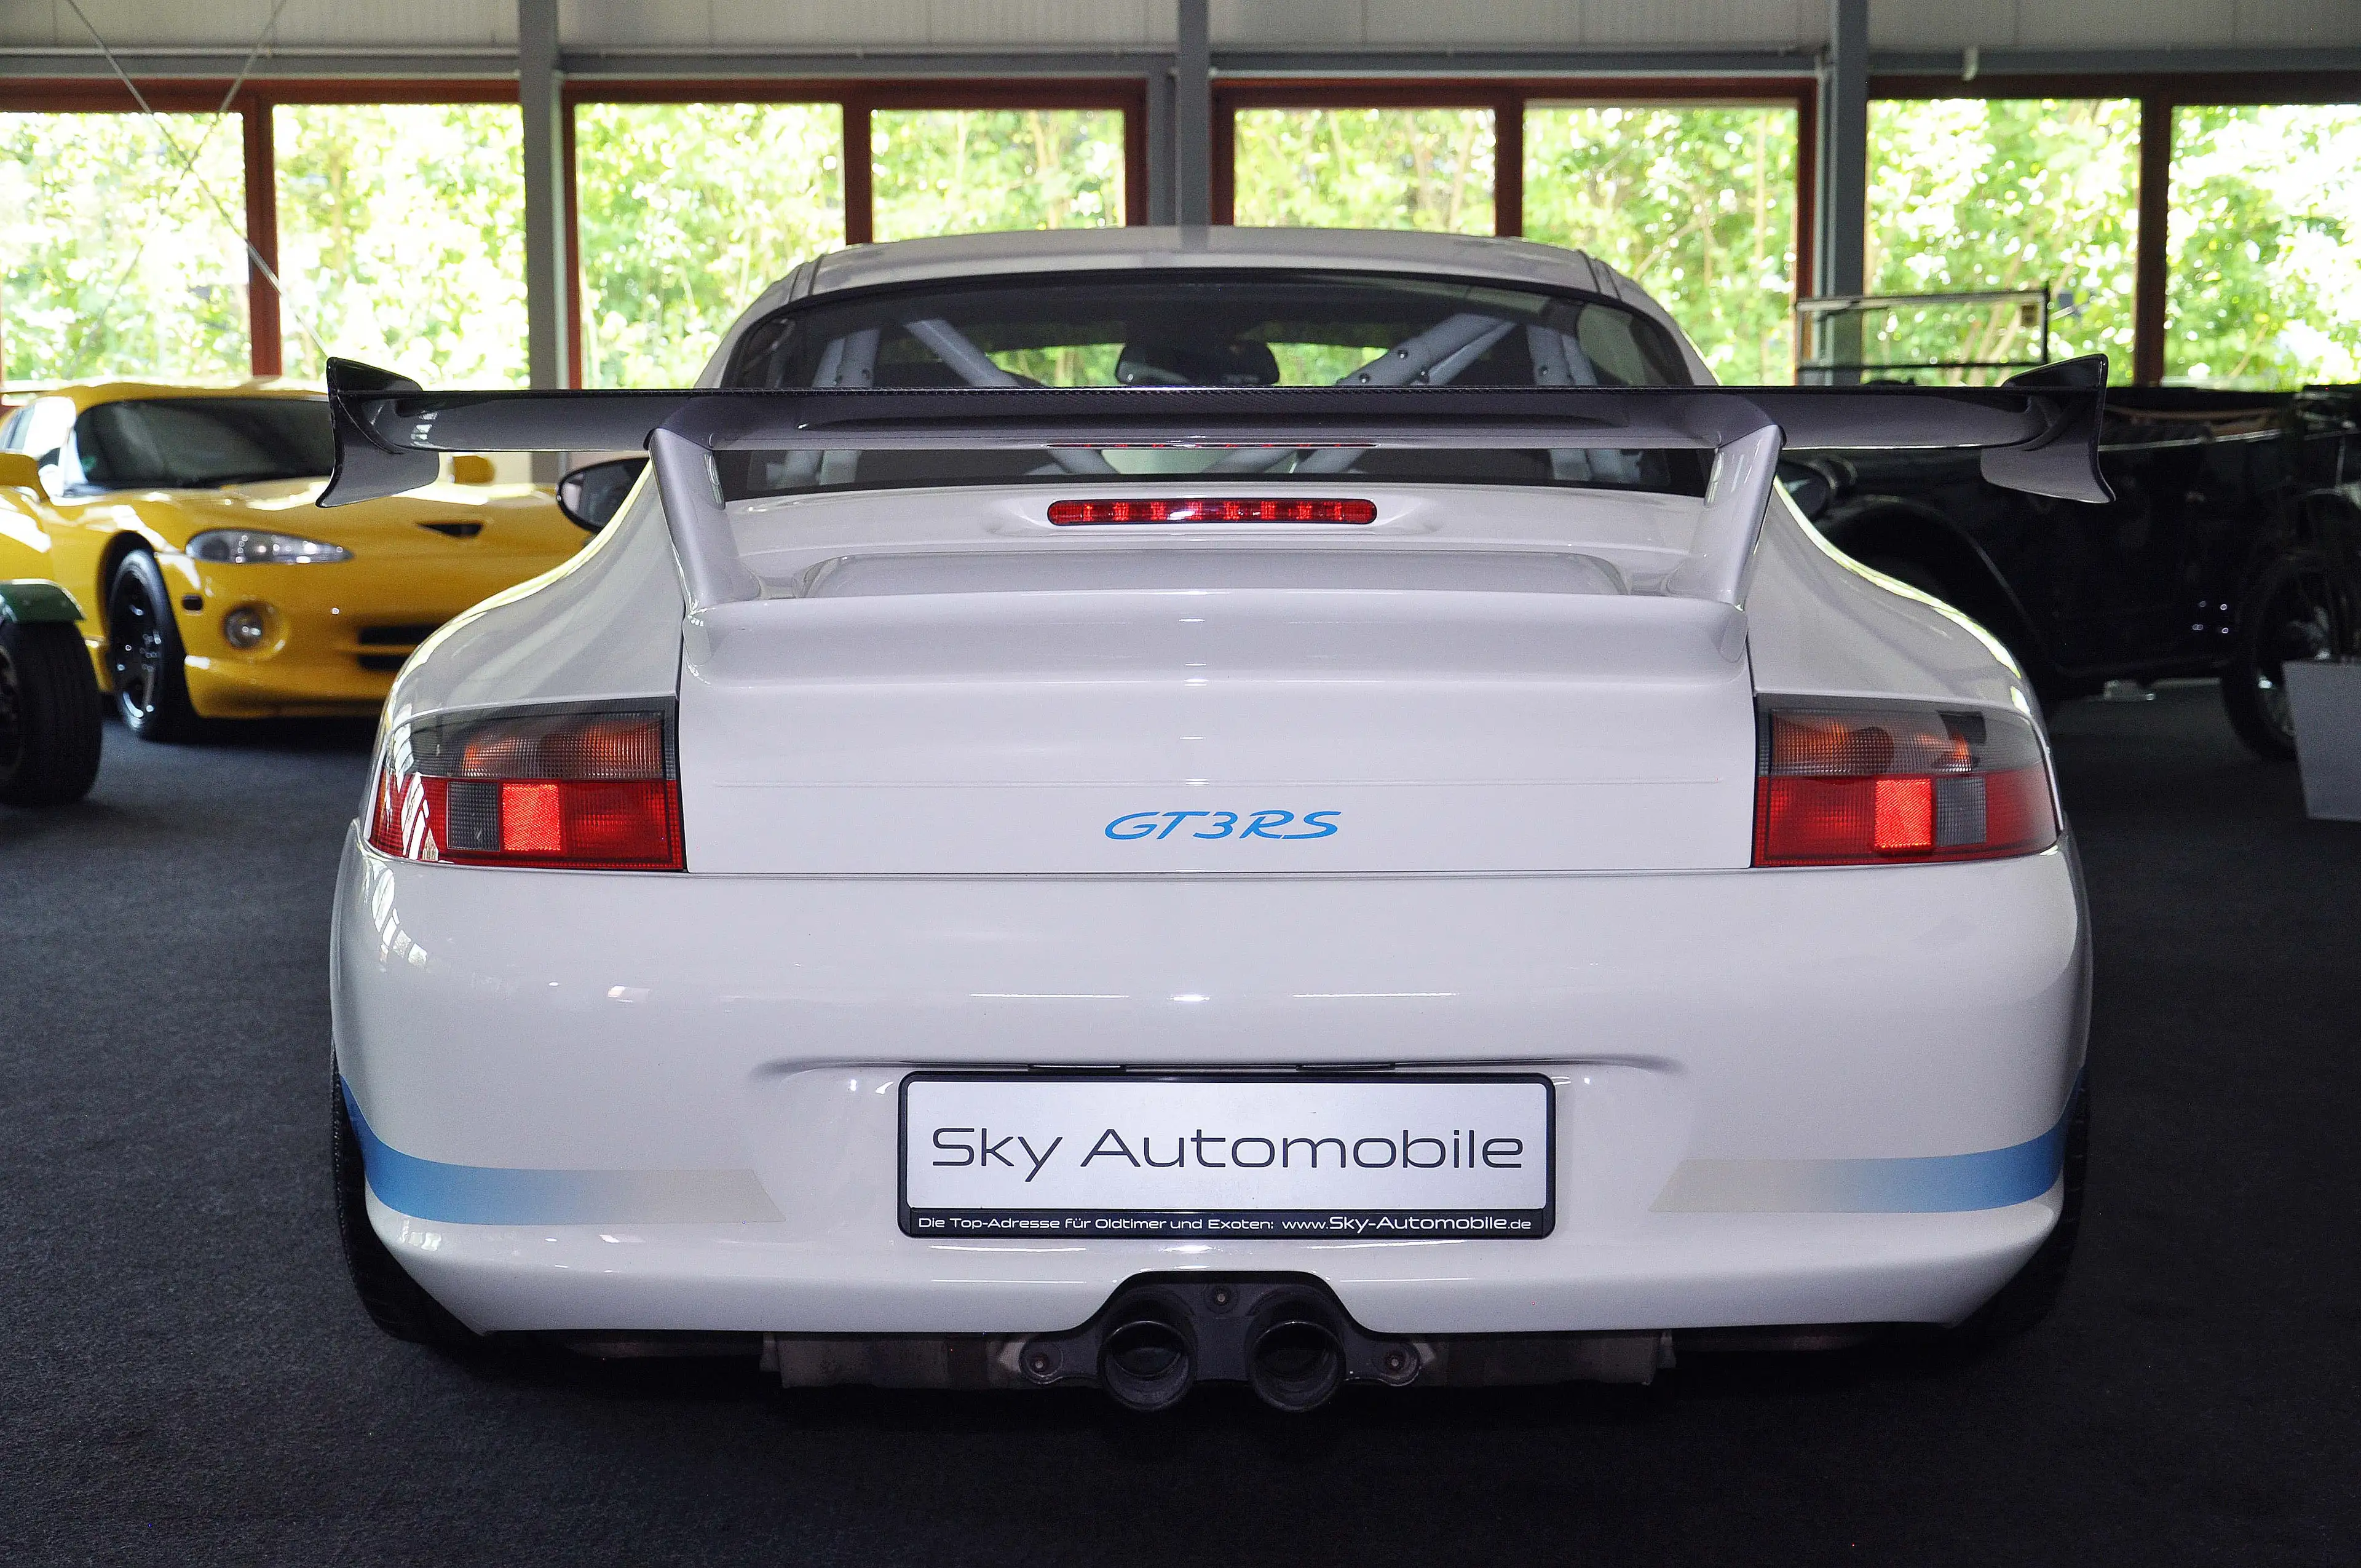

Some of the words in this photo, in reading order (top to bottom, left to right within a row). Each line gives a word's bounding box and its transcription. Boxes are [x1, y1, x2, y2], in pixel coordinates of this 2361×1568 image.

[932, 1128, 1063, 1182] Sky
[1080, 1128, 1524, 1168] Automobile
[919, 1217, 945, 1228] Die
[949, 1218, 1060, 1230] Top-Adresse
[1065, 1218, 1091, 1229] für
[1095, 1218, 1167, 1229] Oldtimer
[1170, 1219, 1203, 1229] und
[1208, 1219, 1274, 1229] Exoten:
[1281, 1216, 1532, 1234] www.Sky-Automobile.de
